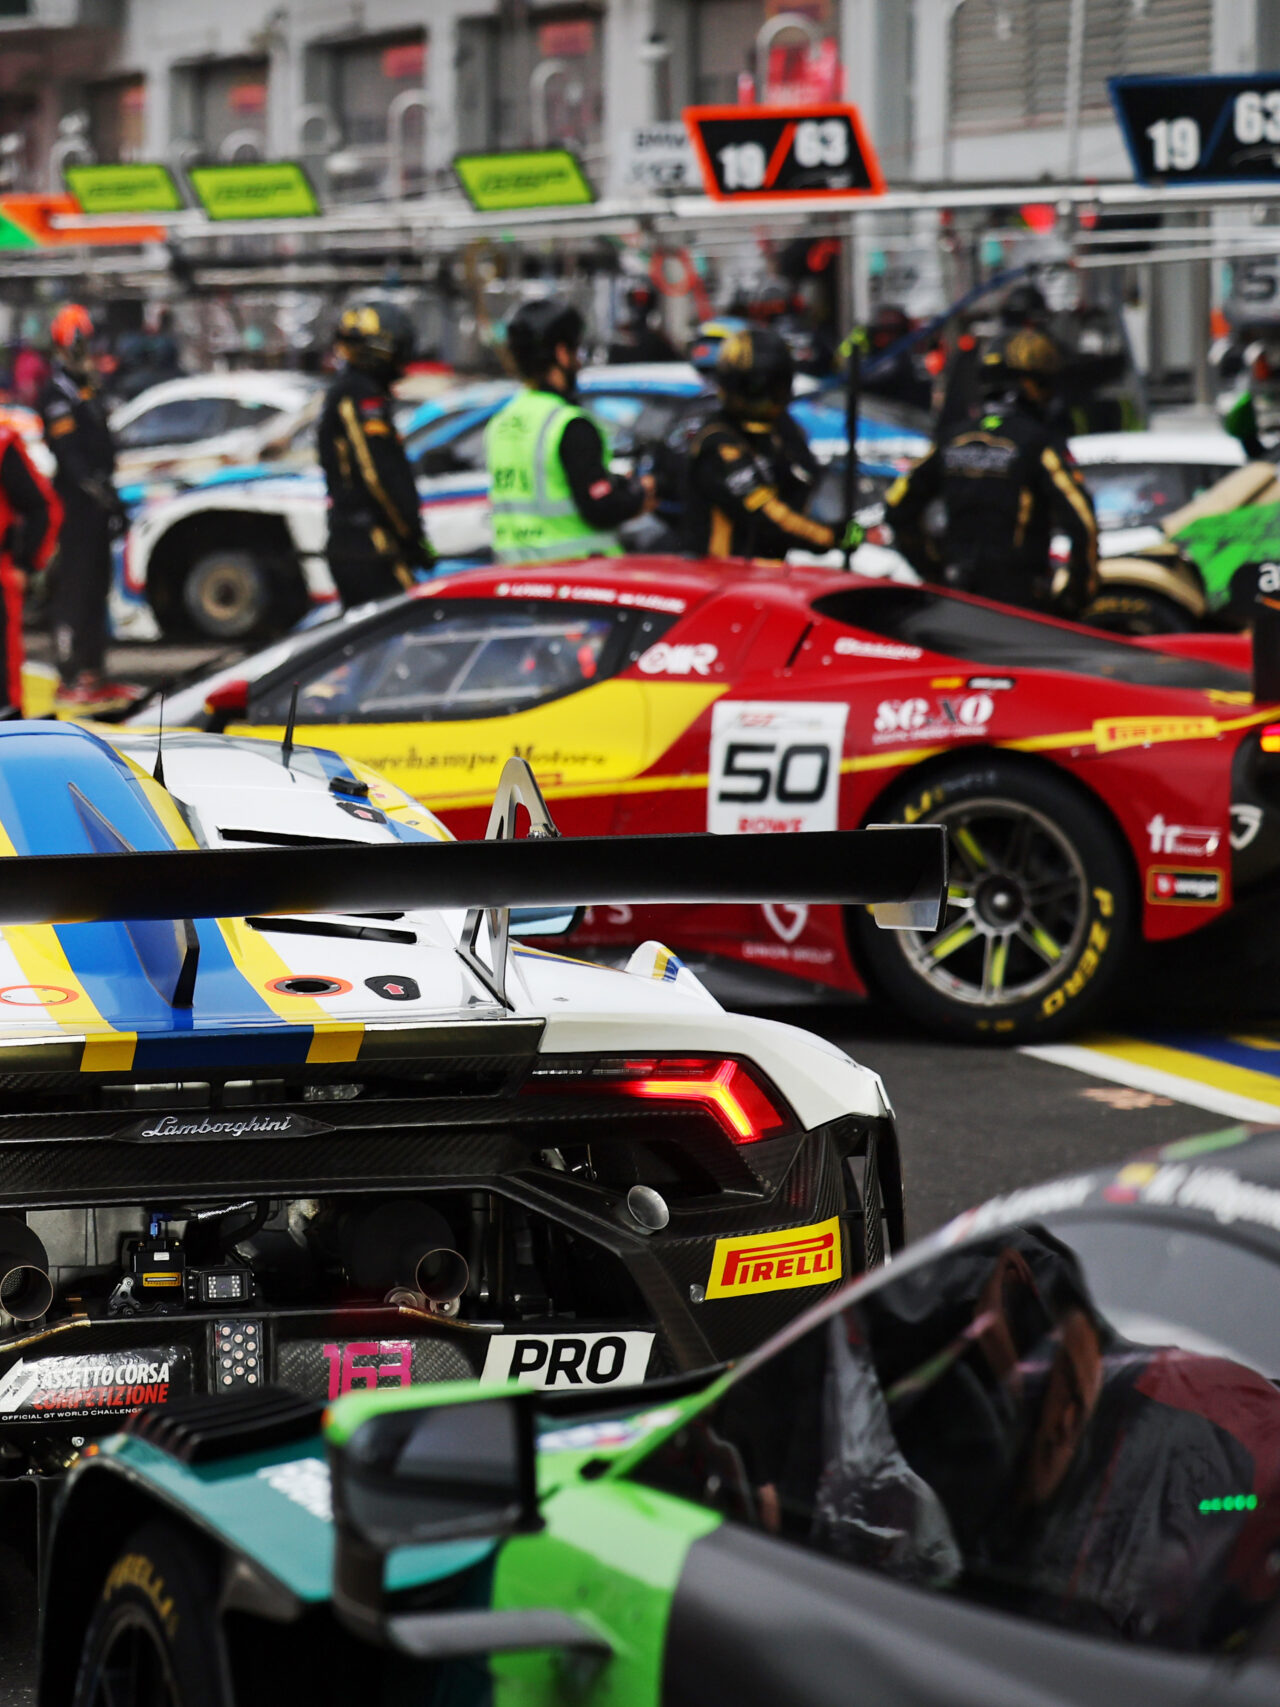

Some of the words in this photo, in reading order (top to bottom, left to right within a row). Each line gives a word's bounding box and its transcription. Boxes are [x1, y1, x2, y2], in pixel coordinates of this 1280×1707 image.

[794, 119, 848, 167] 63
[1146, 117, 1200, 171] 19
[718, 743, 830, 803] 50
[142, 1116, 292, 1138] Lamborghini
[721, 1232, 834, 1286] PIRELLI
[34, 1366, 113, 1390] ASSETTO
[115, 1362, 170, 1384] CORSA
[323, 1341, 412, 1400] 163
[506, 1336, 627, 1386] PRO
[1, 1413, 42, 1421] OFFICIAL
[57, 1410, 90, 1418] WORLD
[33, 1383, 170, 1410] COMPETIZIONE
